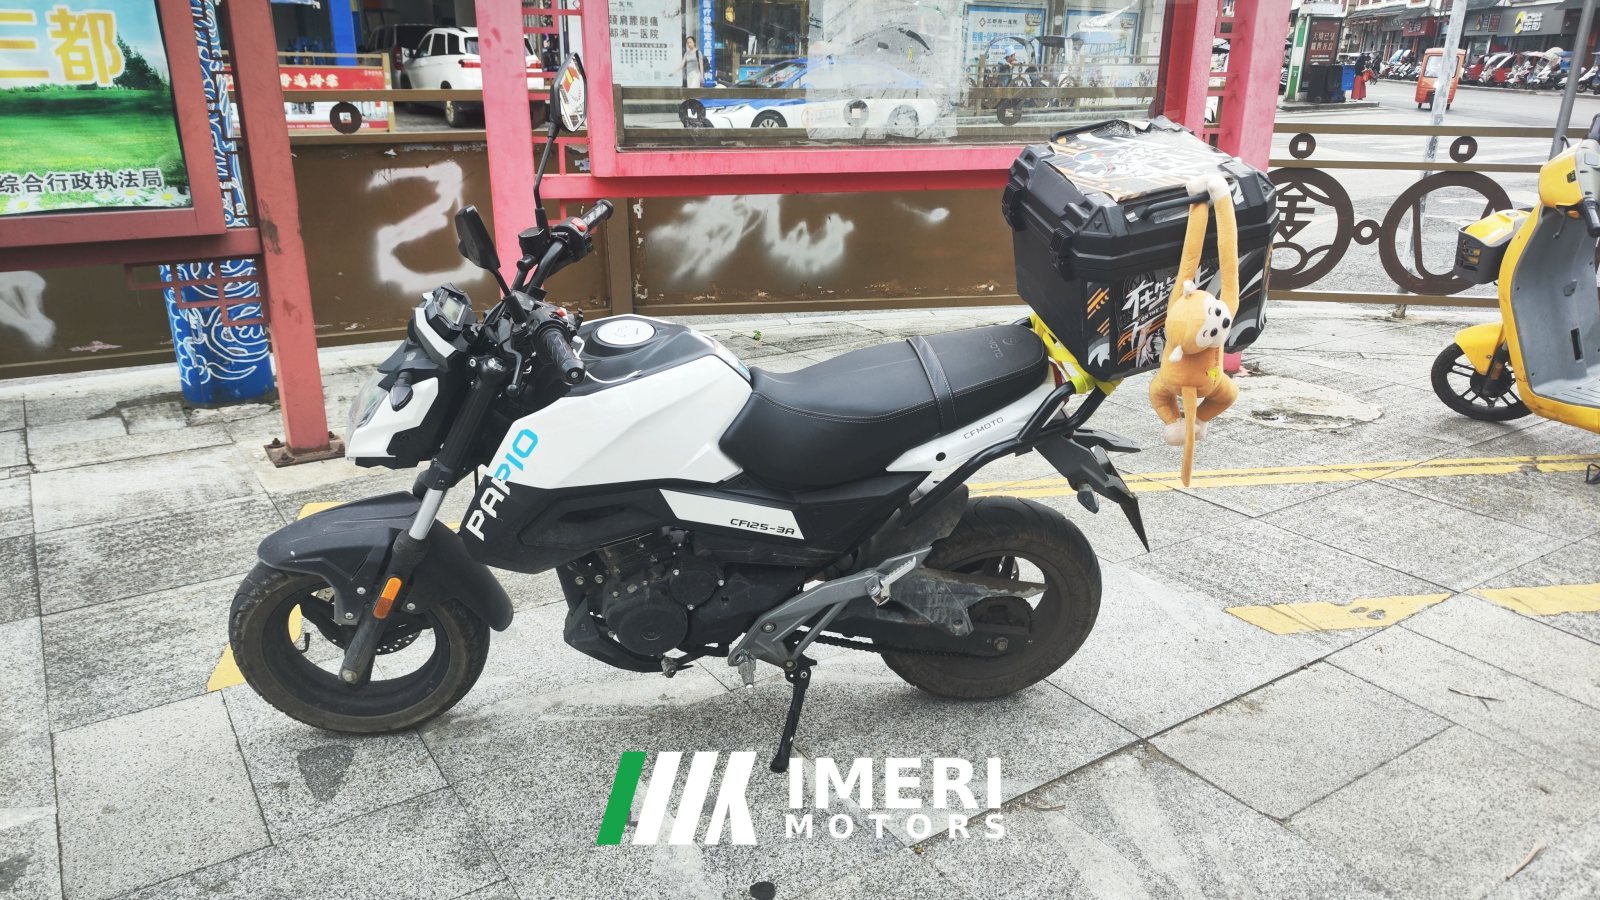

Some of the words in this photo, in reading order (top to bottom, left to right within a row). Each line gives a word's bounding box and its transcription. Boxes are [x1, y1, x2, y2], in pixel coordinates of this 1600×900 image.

[0, 6, 124, 85] 三都
[0, 170, 163, 193] 综合行政执法局
[963, 416, 1004, 440] CFMOTO
[466, 428, 539, 542] PAPIO
[729, 517, 796, 536] CF125-3A
